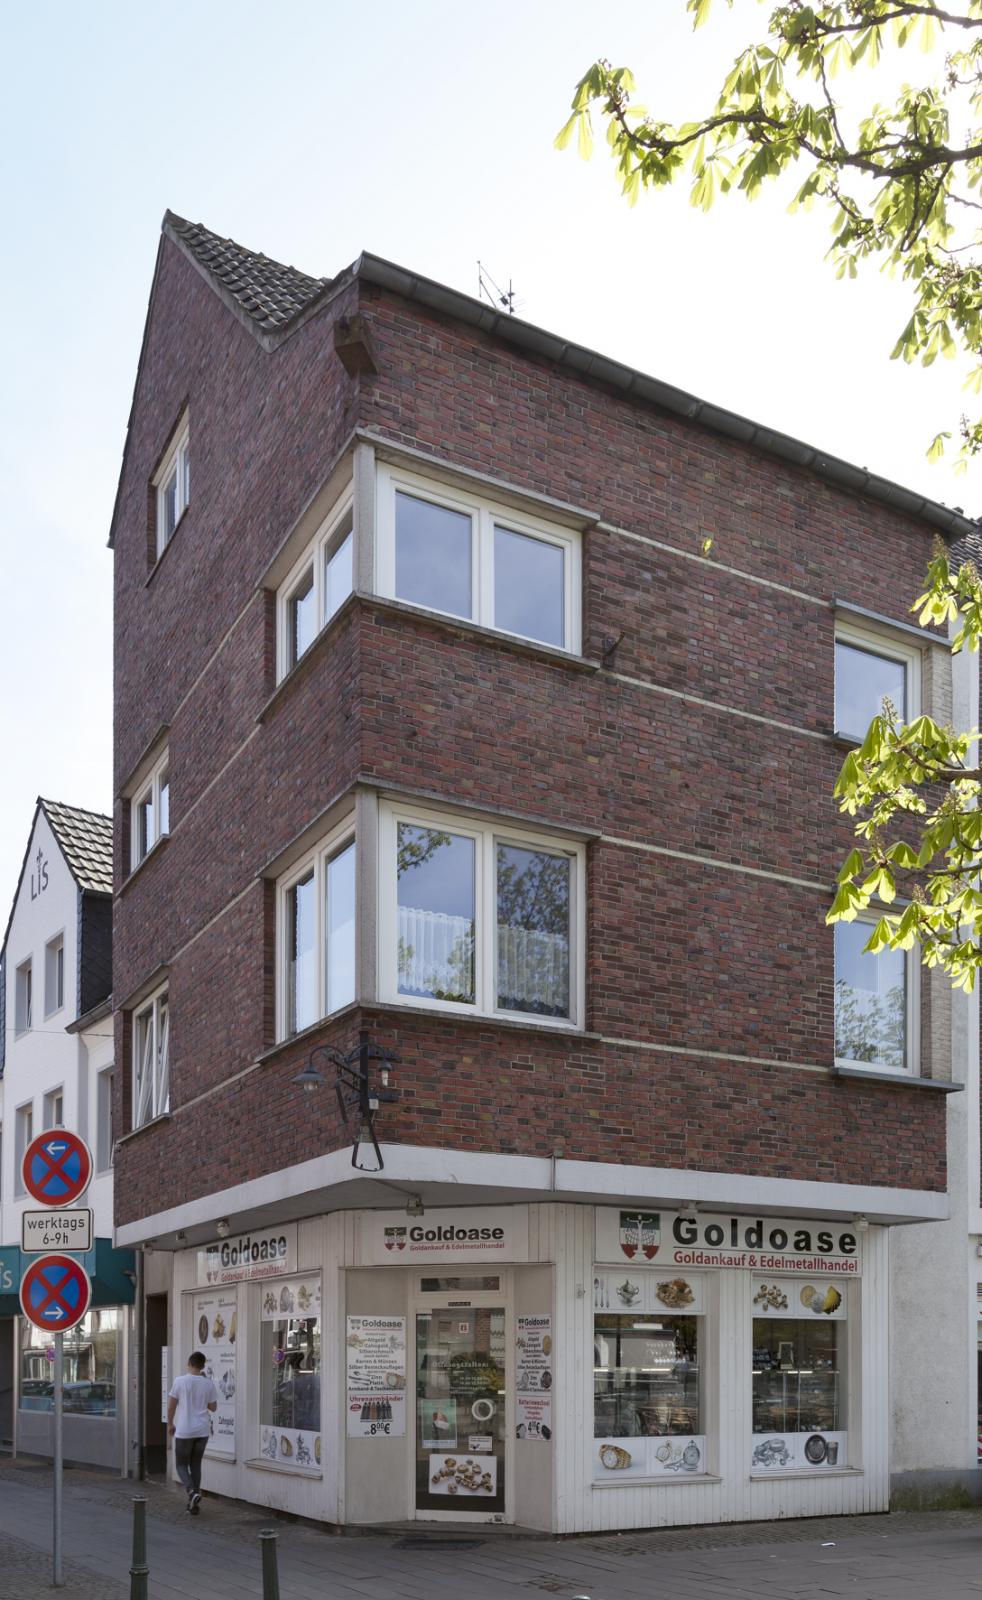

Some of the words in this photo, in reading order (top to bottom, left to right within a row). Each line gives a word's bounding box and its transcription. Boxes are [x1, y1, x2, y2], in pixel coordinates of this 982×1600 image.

[27, 1216, 85, 1231] werktags
[409, 1226, 505, 1242] Goldoase
[672, 1216, 858, 1254] Goldoase
[220, 1235, 287, 1268] Goldoase
[409, 1244, 445, 1252] Goldankauf
[673, 1250, 747, 1267] Goldankauf
[748, 1255, 758, 1267] &
[760, 1253, 859, 1272] Edelmetallhandel
[362, 1319, 402, 1328] Goldoase
